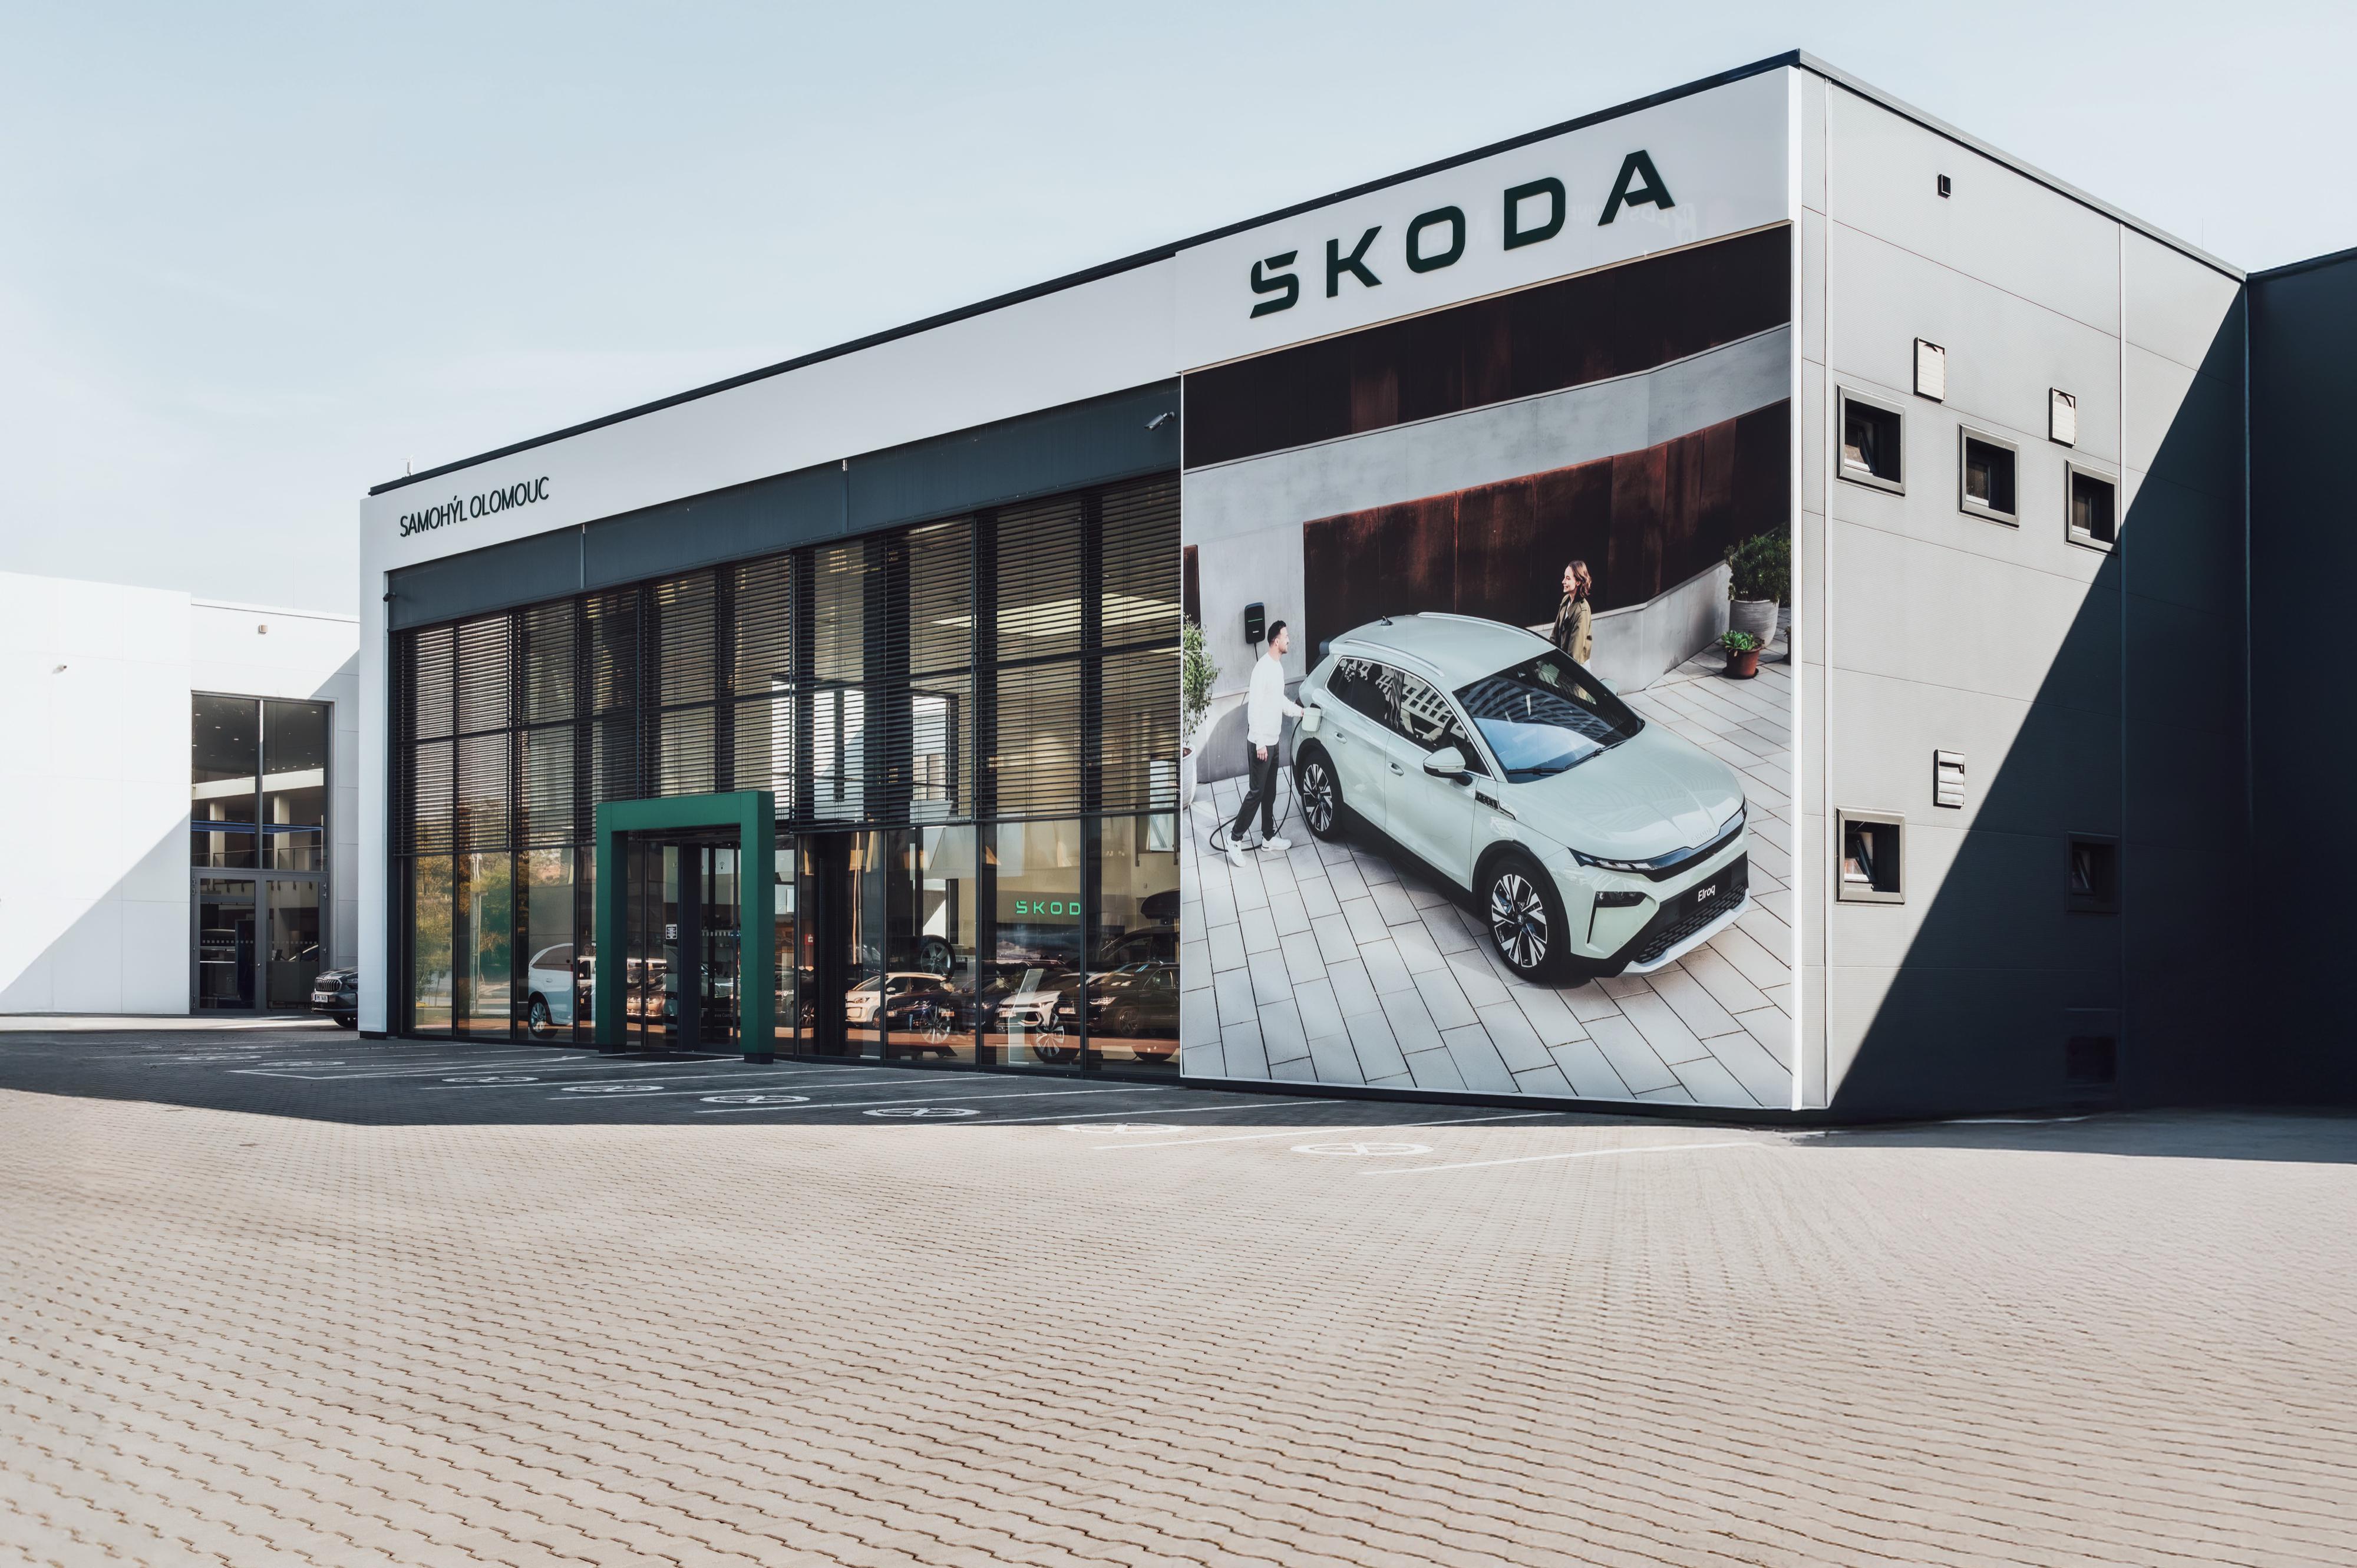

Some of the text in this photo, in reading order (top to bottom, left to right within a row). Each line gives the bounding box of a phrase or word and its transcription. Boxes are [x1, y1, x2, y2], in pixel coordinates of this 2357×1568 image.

[400, 476, 549, 537] SAMOHÝL OLOMOUC
[1698, 885, 1715, 902] Elroq
[1016, 900, 1081, 915] SKOD
